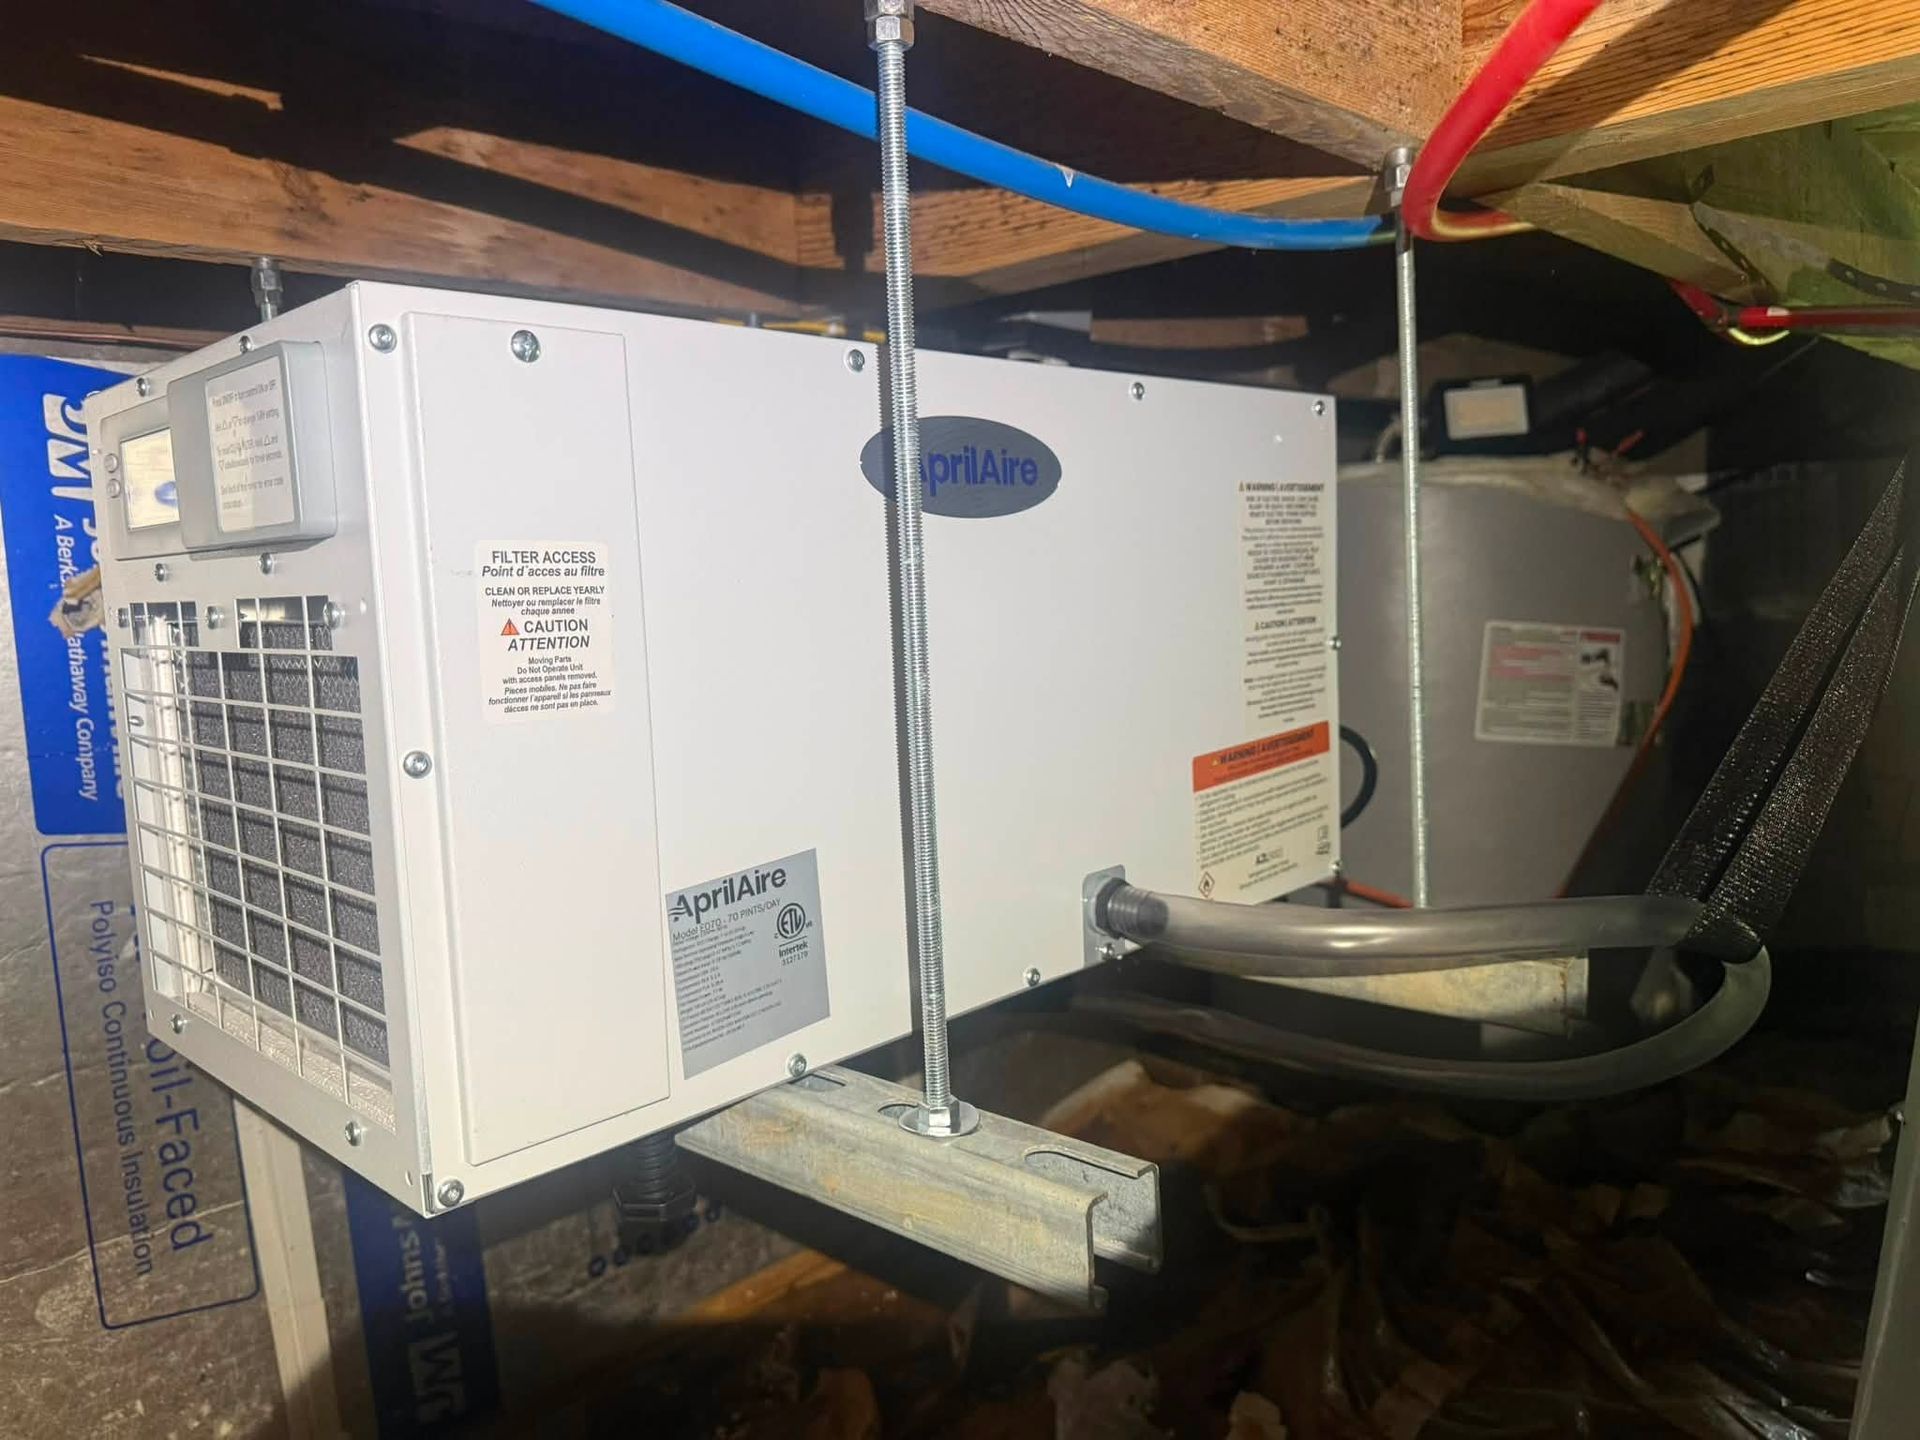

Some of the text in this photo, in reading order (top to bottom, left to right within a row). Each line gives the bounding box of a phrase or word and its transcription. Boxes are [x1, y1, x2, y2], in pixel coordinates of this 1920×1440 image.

[54, 514, 73, 530] A
[492, 551, 596, 564] FILTER ACCESS
[482, 566, 514, 577] Point
[564, 568, 578, 576] au
[580, 565, 605, 576] filtre
[485, 586, 605, 596] CLEAN OR REPLACE YEARLY
[492, 598, 524, 609] Nettoyer
[538, 598, 574, 608] remplacer
[584, 597, 600, 606] filtre
[521, 608, 550, 617] chaque
[524, 618, 588, 634] CAUTION
[508, 635, 590, 652] ATTENTION
[528, 657, 554, 665] Moving
[528, 666, 541, 674] Not
[542, 665, 568, 674] Operate
[570, 664, 584, 672] Unit
[67, 632, 89, 713] athaway
[502, 676, 518, 684] with
[519, 676, 542, 684] access
[544, 674, 566, 683] panels
[559, 682, 568, 691] Ne
[569, 684, 581, 692] pas
[582, 681, 597, 689] faire
[75, 717, 98, 801] Company
[669, 868, 787, 925] AprilAire
[673, 922, 700, 942] Model
[728, 912, 740, 923] 70
[740, 898, 780, 920] PINTS/DAY
[90, 901, 118, 993] Polyiso
[779, 940, 808, 958] Intertek
[102, 1001, 136, 1146] Continuous
[121, 1151, 153, 1276] Insulation
